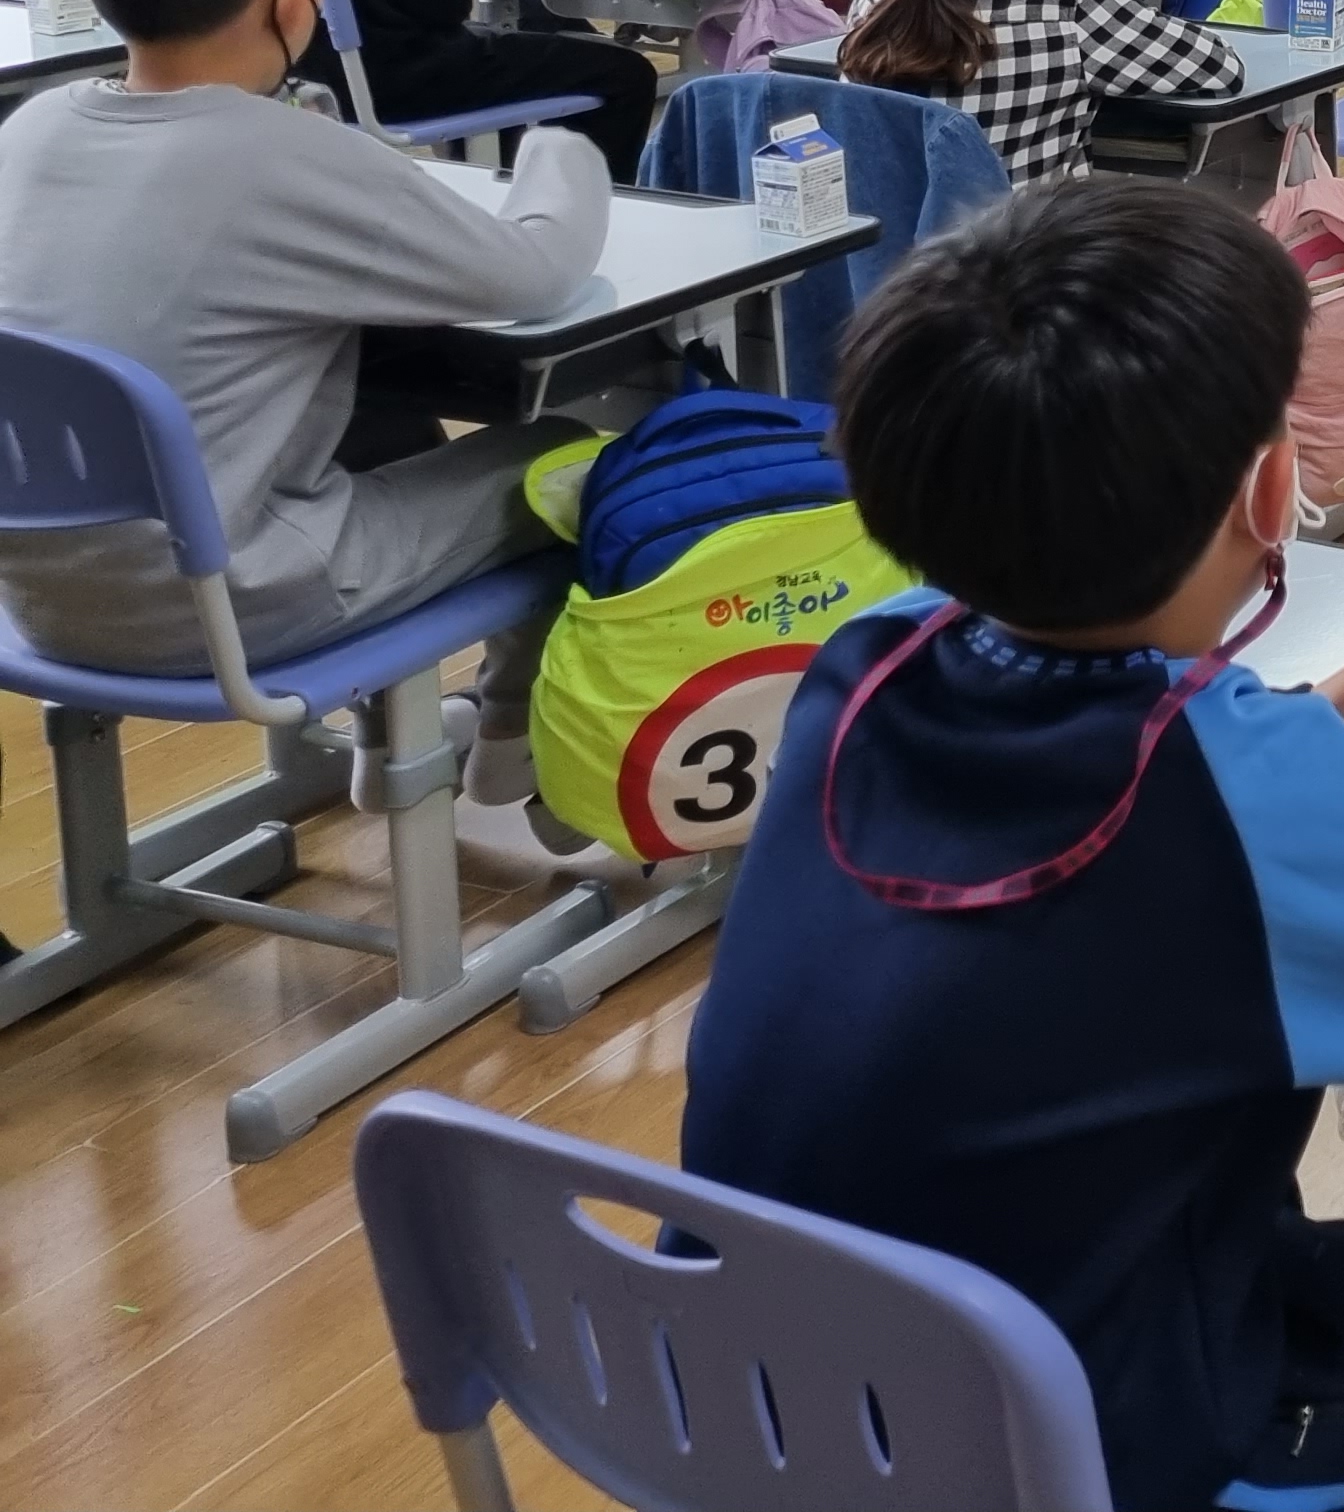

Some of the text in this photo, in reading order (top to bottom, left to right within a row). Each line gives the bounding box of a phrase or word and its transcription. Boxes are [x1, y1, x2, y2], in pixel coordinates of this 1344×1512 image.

[1297, 0, 1327, 9] Health
[1297, 7, 1327, 17] Doctor
[775, 570, 822, 588] 경남교육
[705, 580, 849, 637] 아이좋아
[672, 729, 757, 822] 3
